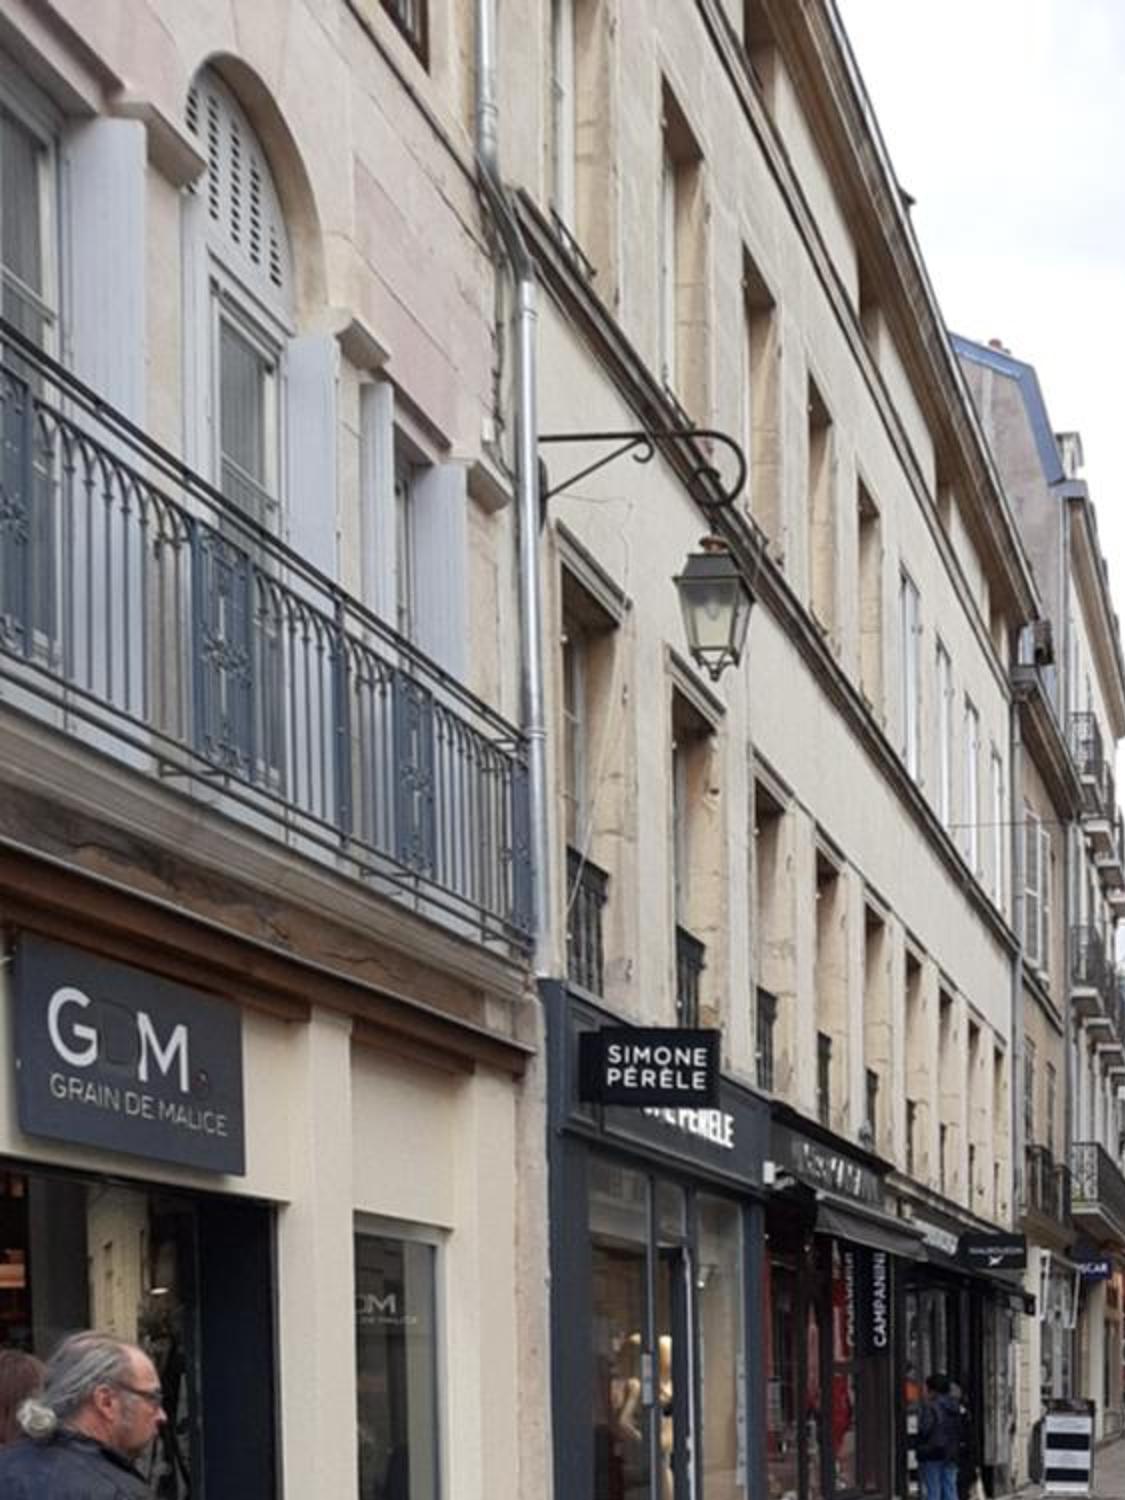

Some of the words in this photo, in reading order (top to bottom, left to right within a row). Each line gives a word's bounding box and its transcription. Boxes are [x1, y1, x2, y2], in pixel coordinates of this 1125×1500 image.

[608, 1044, 708, 1067] SIMONE
[49, 1072, 121, 1111] GRAIN
[124, 1090, 154, 1119] DE
[158, 1101, 228, 1136] MALICE
[873, 1252, 887, 1347] CAMPANINI
